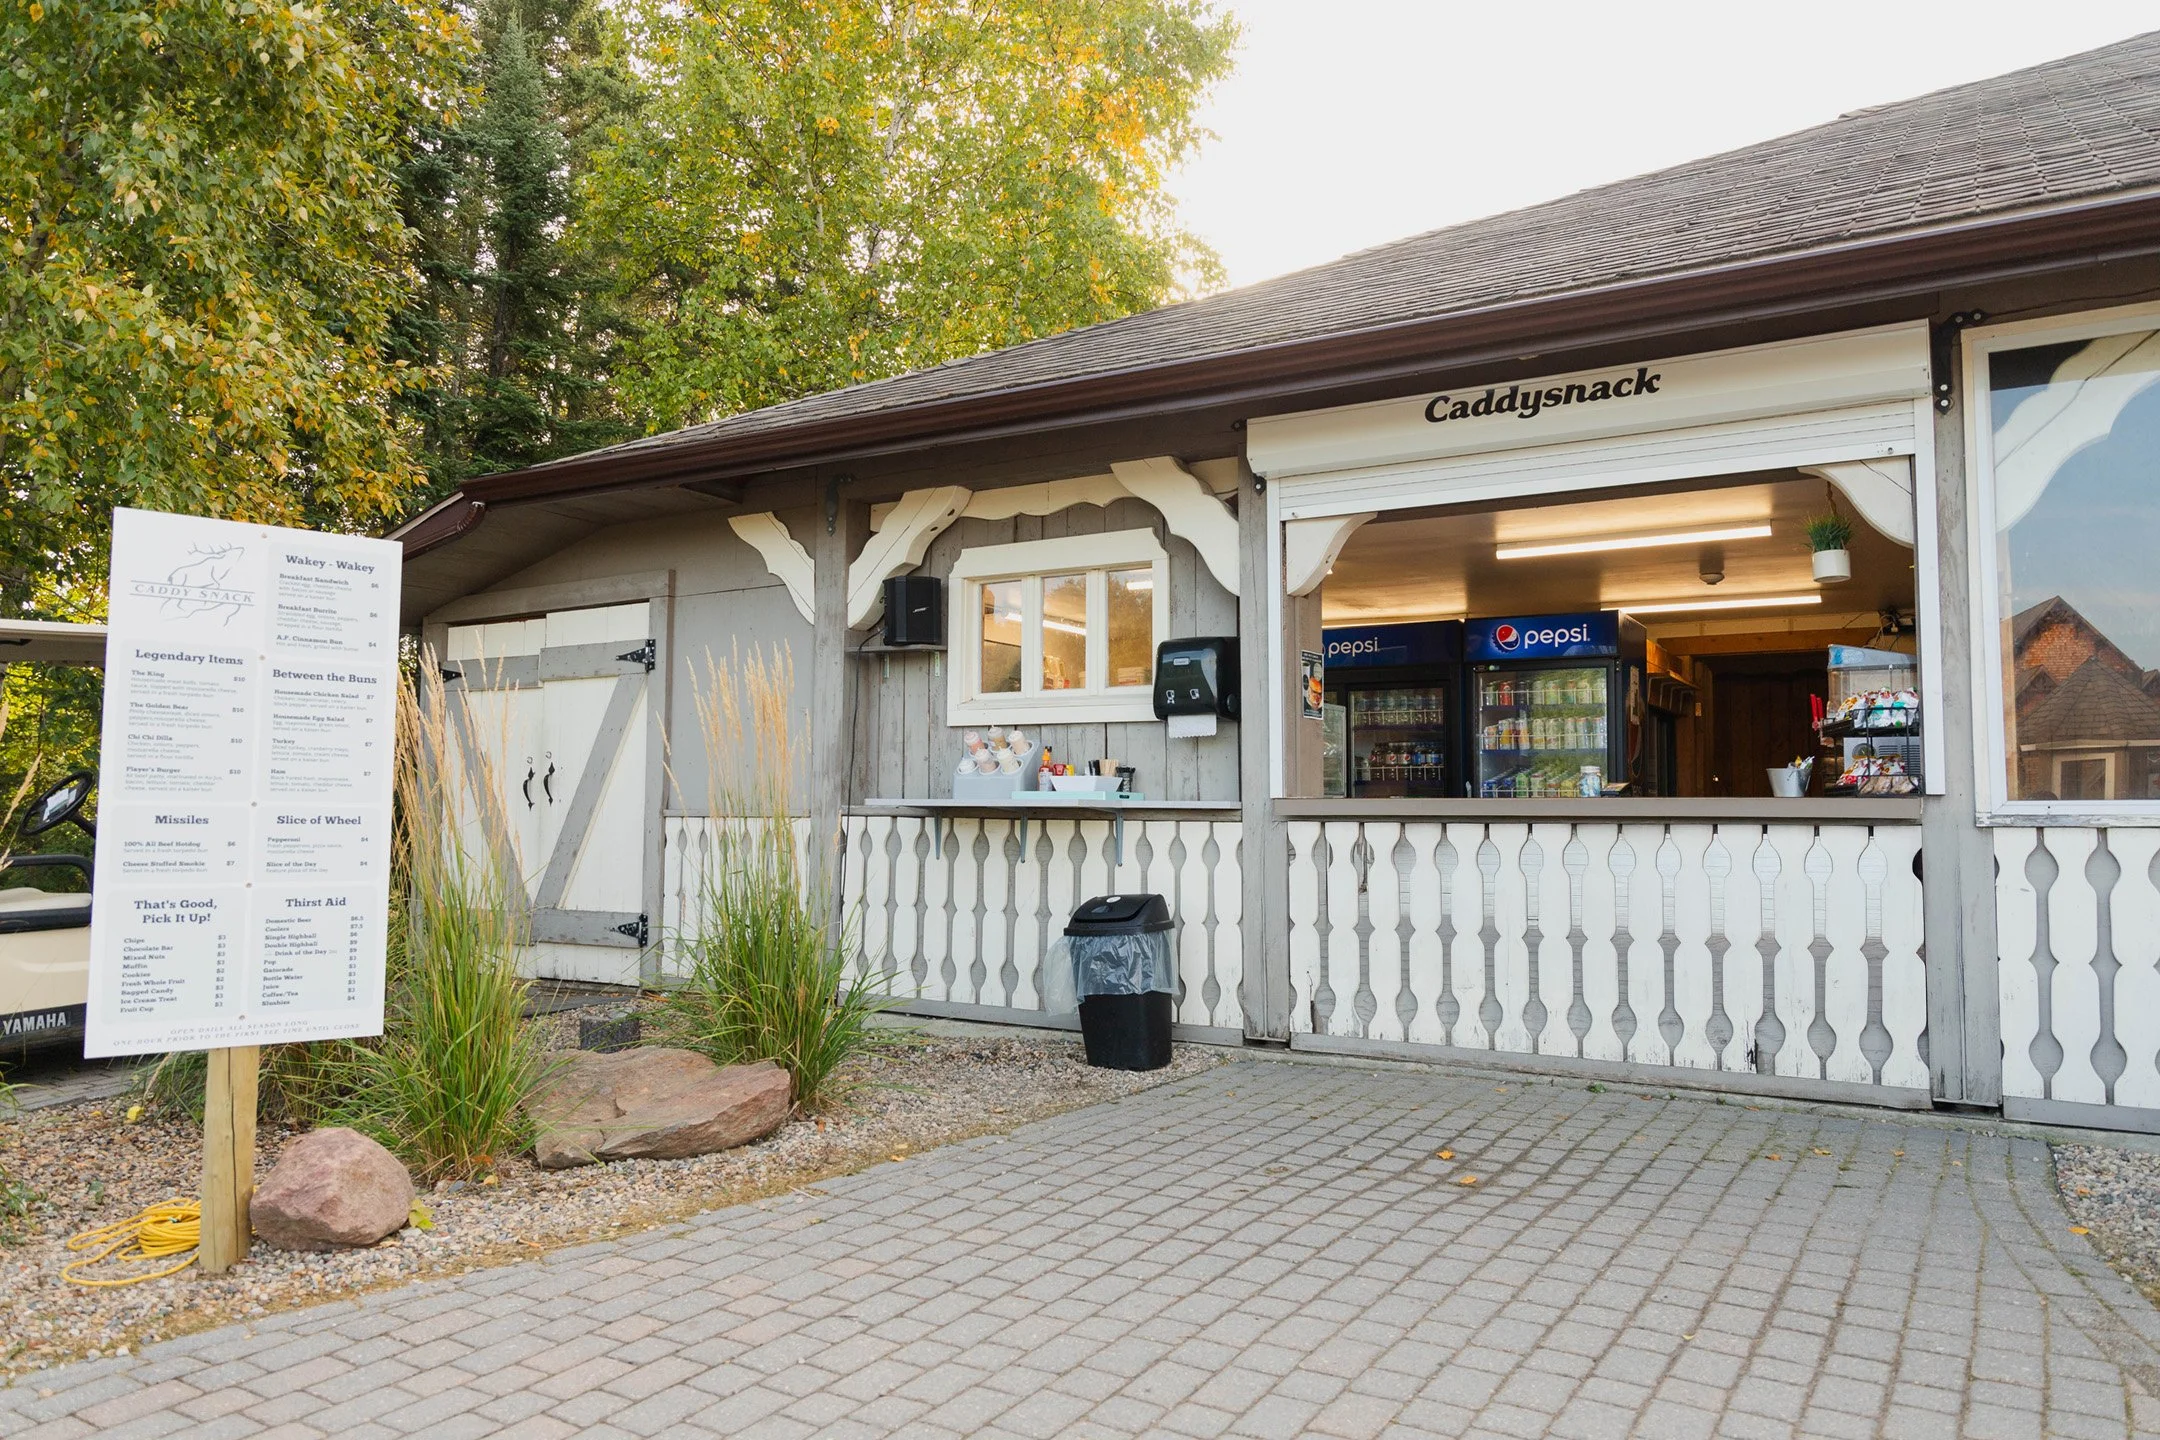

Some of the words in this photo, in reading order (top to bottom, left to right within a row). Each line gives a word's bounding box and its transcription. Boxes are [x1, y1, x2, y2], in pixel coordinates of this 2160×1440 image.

[1424, 367, 1662, 423] Caddysnack
[285, 554, 326, 569] Wakey
[336, 560, 375, 575] Wakey
[279, 573, 313, 582] Breakfast
[314, 577, 349, 585] Sandwich
[134, 583, 191, 597] CADDY
[199, 589, 253, 602] SNACK
[278, 604, 312, 612] Breakfast
[1524, 624, 1589, 649] pepsi
[1328, 636, 1379, 658] pepsi
[135, 649, 205, 664] Legendary
[209, 654, 243, 665] Items
[272, 669, 324, 680] Between
[327, 672, 345, 682] the
[349, 673, 377, 684] Buns
[154, 815, 209, 824] Missiles
[276, 815, 306, 824] Slice
[310, 816, 322, 824] of
[325, 816, 361, 825] Wheel
[134, 899, 176, 910] That's
[180, 898, 217, 910] Good,
[285, 897, 322, 907] Thirst
[325, 897, 346, 906] Aid
[142, 914, 171, 923] Pick
[175, 913, 185, 922] It
[189, 912, 211, 924] Up!
[121, 989, 149, 997] Bagged
[150, 987, 173, 995] Candy
[139, 1005, 154, 1013] Cup
[2, 1011, 67, 1035] YAMAHA
